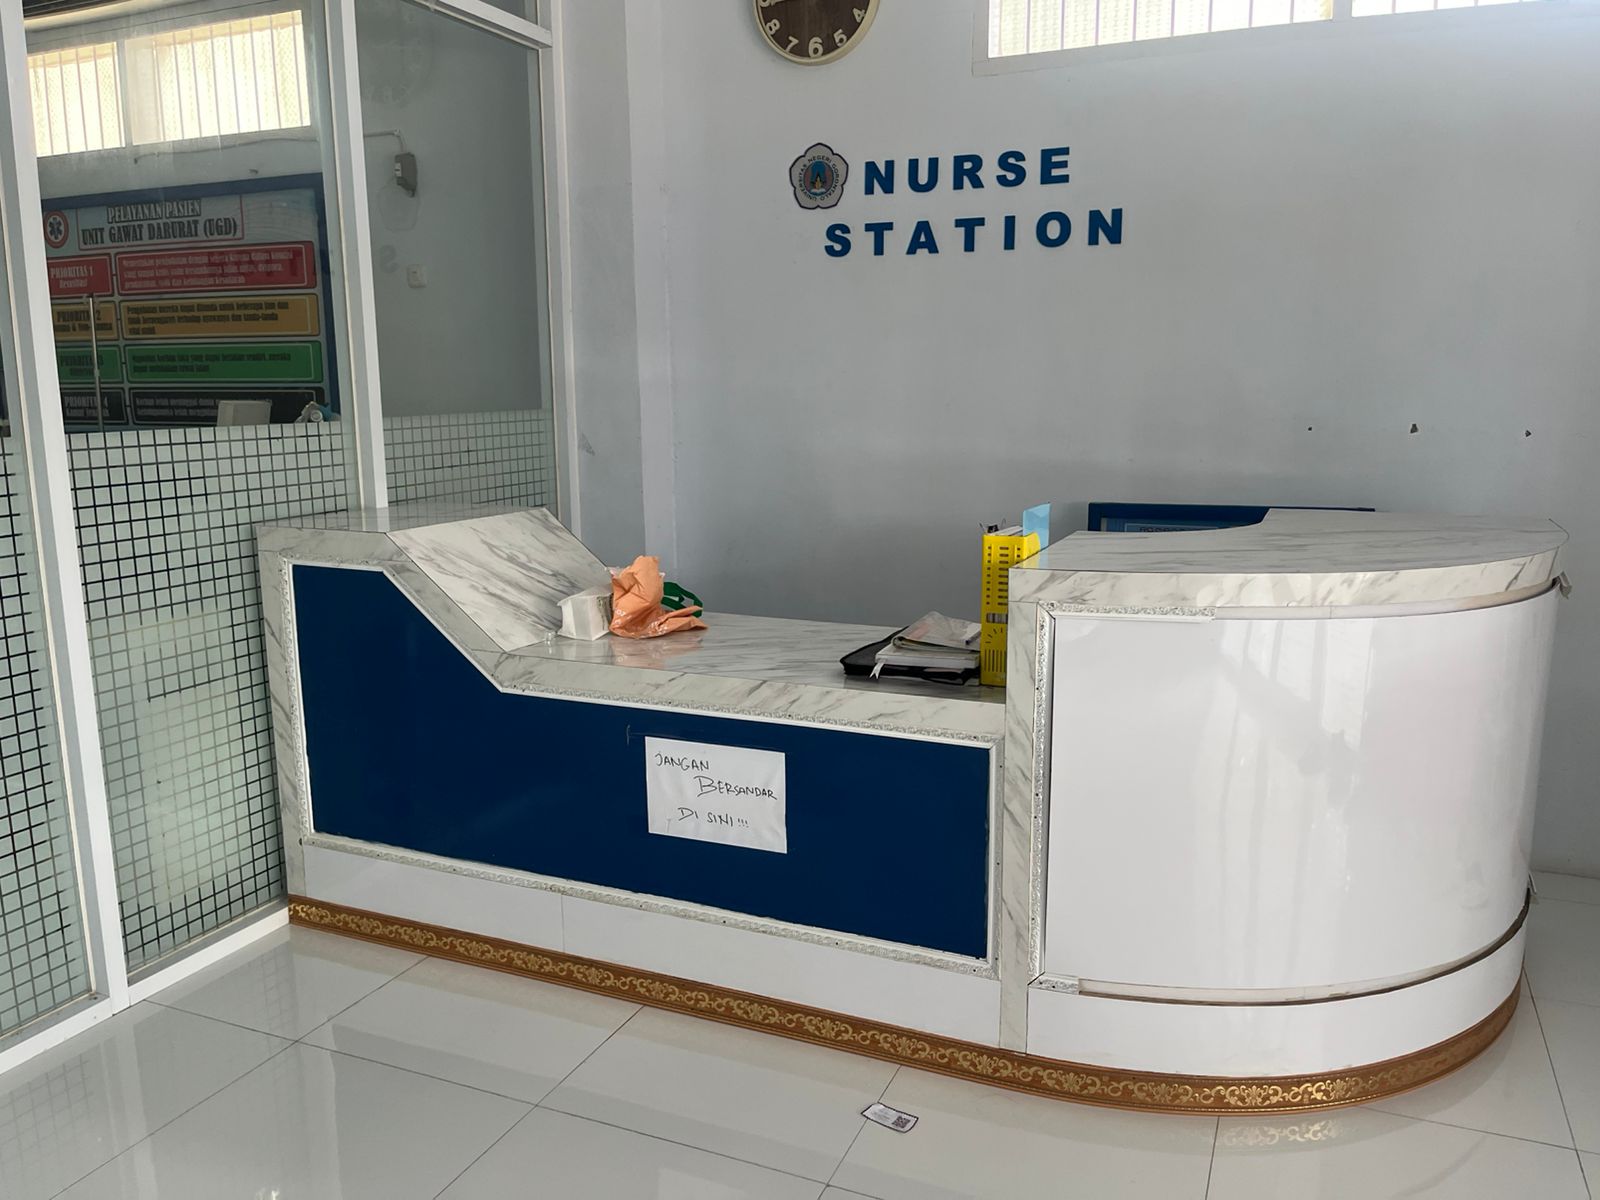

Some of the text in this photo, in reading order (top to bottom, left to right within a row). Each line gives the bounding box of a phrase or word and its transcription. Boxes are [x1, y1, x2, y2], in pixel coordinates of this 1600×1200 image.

[852, 7, 865, 23] 4
[766, 19, 780, 35] 8
[785, 36, 799, 53] 7
[808, 36, 824, 58] 6
[833, 29, 848, 47] 5
[864, 147, 1070, 195] NURSE
[107, 199, 202, 224] PELAYANAN PASIEN
[81, 217, 238, 246] UNIT GAWAT DARURAT (UGD)
[824, 208, 1123, 257] STATION
[655, 753, 710, 771] JANGAN
[693, 775, 778, 800] BERSANDAR
[677, 807, 699, 821] DI
